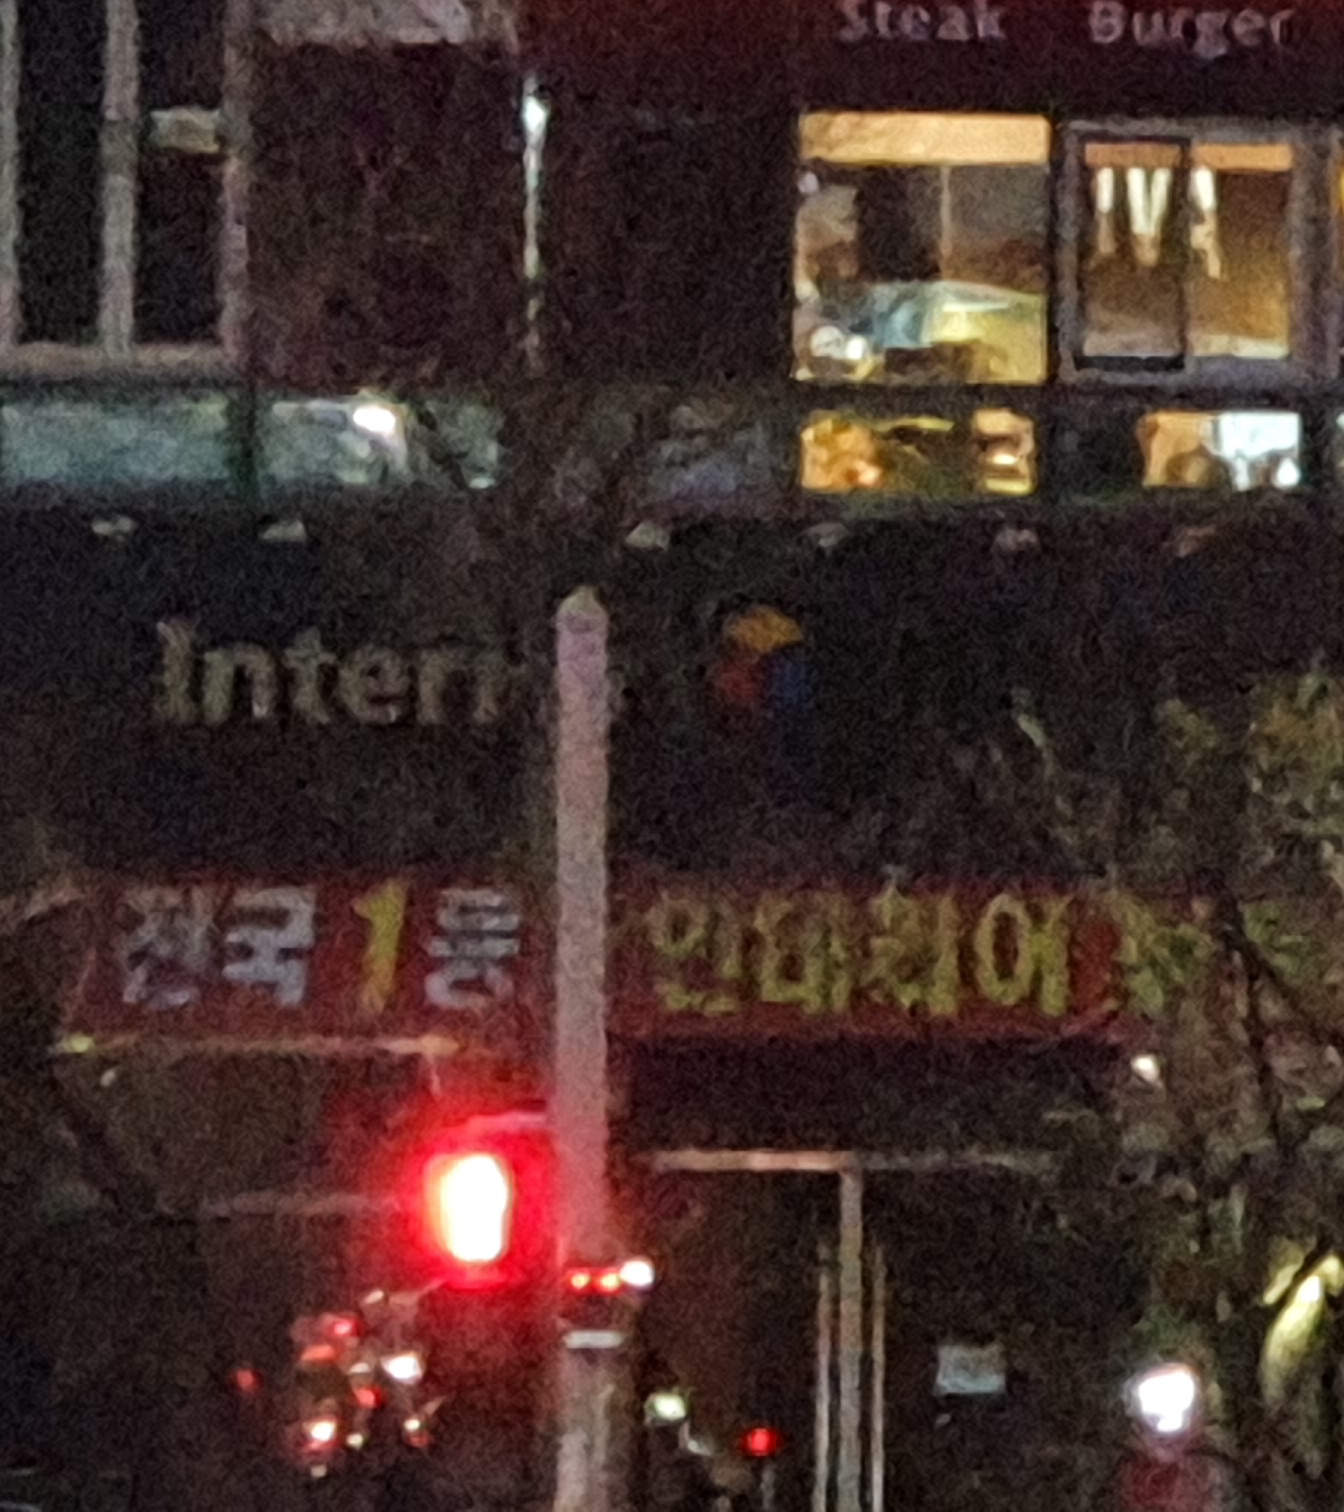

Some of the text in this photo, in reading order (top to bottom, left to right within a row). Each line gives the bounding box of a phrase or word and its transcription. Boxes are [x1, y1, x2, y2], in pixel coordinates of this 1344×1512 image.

[1089, 0, 1298, 60] Burger
[117, 884, 318, 1008] 전국
[352, 878, 522, 1012] 1등
